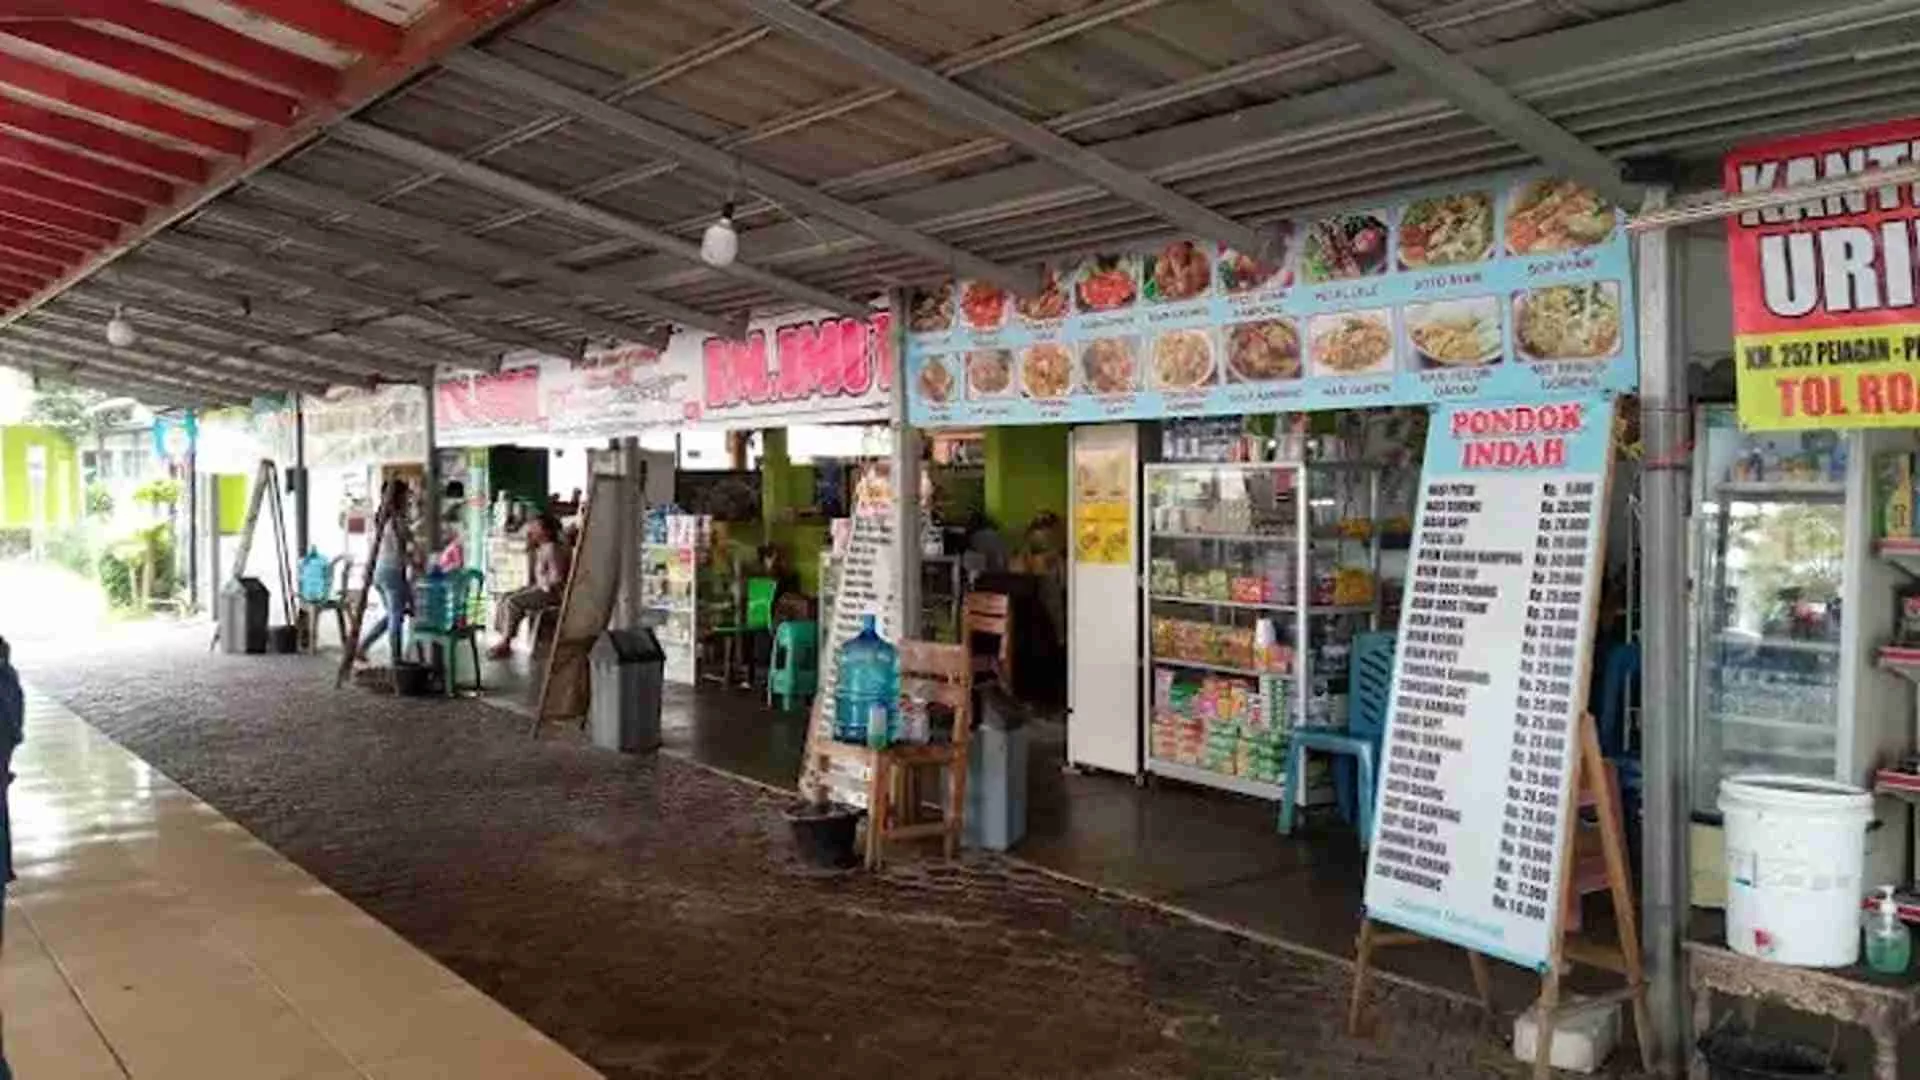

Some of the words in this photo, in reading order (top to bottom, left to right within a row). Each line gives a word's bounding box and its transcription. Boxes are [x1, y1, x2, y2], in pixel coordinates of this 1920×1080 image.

[1780, 341, 1812, 367] 252
[1816, 337, 1889, 365] PEJAGAN
[1776, 375, 1848, 417] TOL
[1452, 404, 1583, 435] PONDOK
[1462, 439, 1566, 468] INDAH
